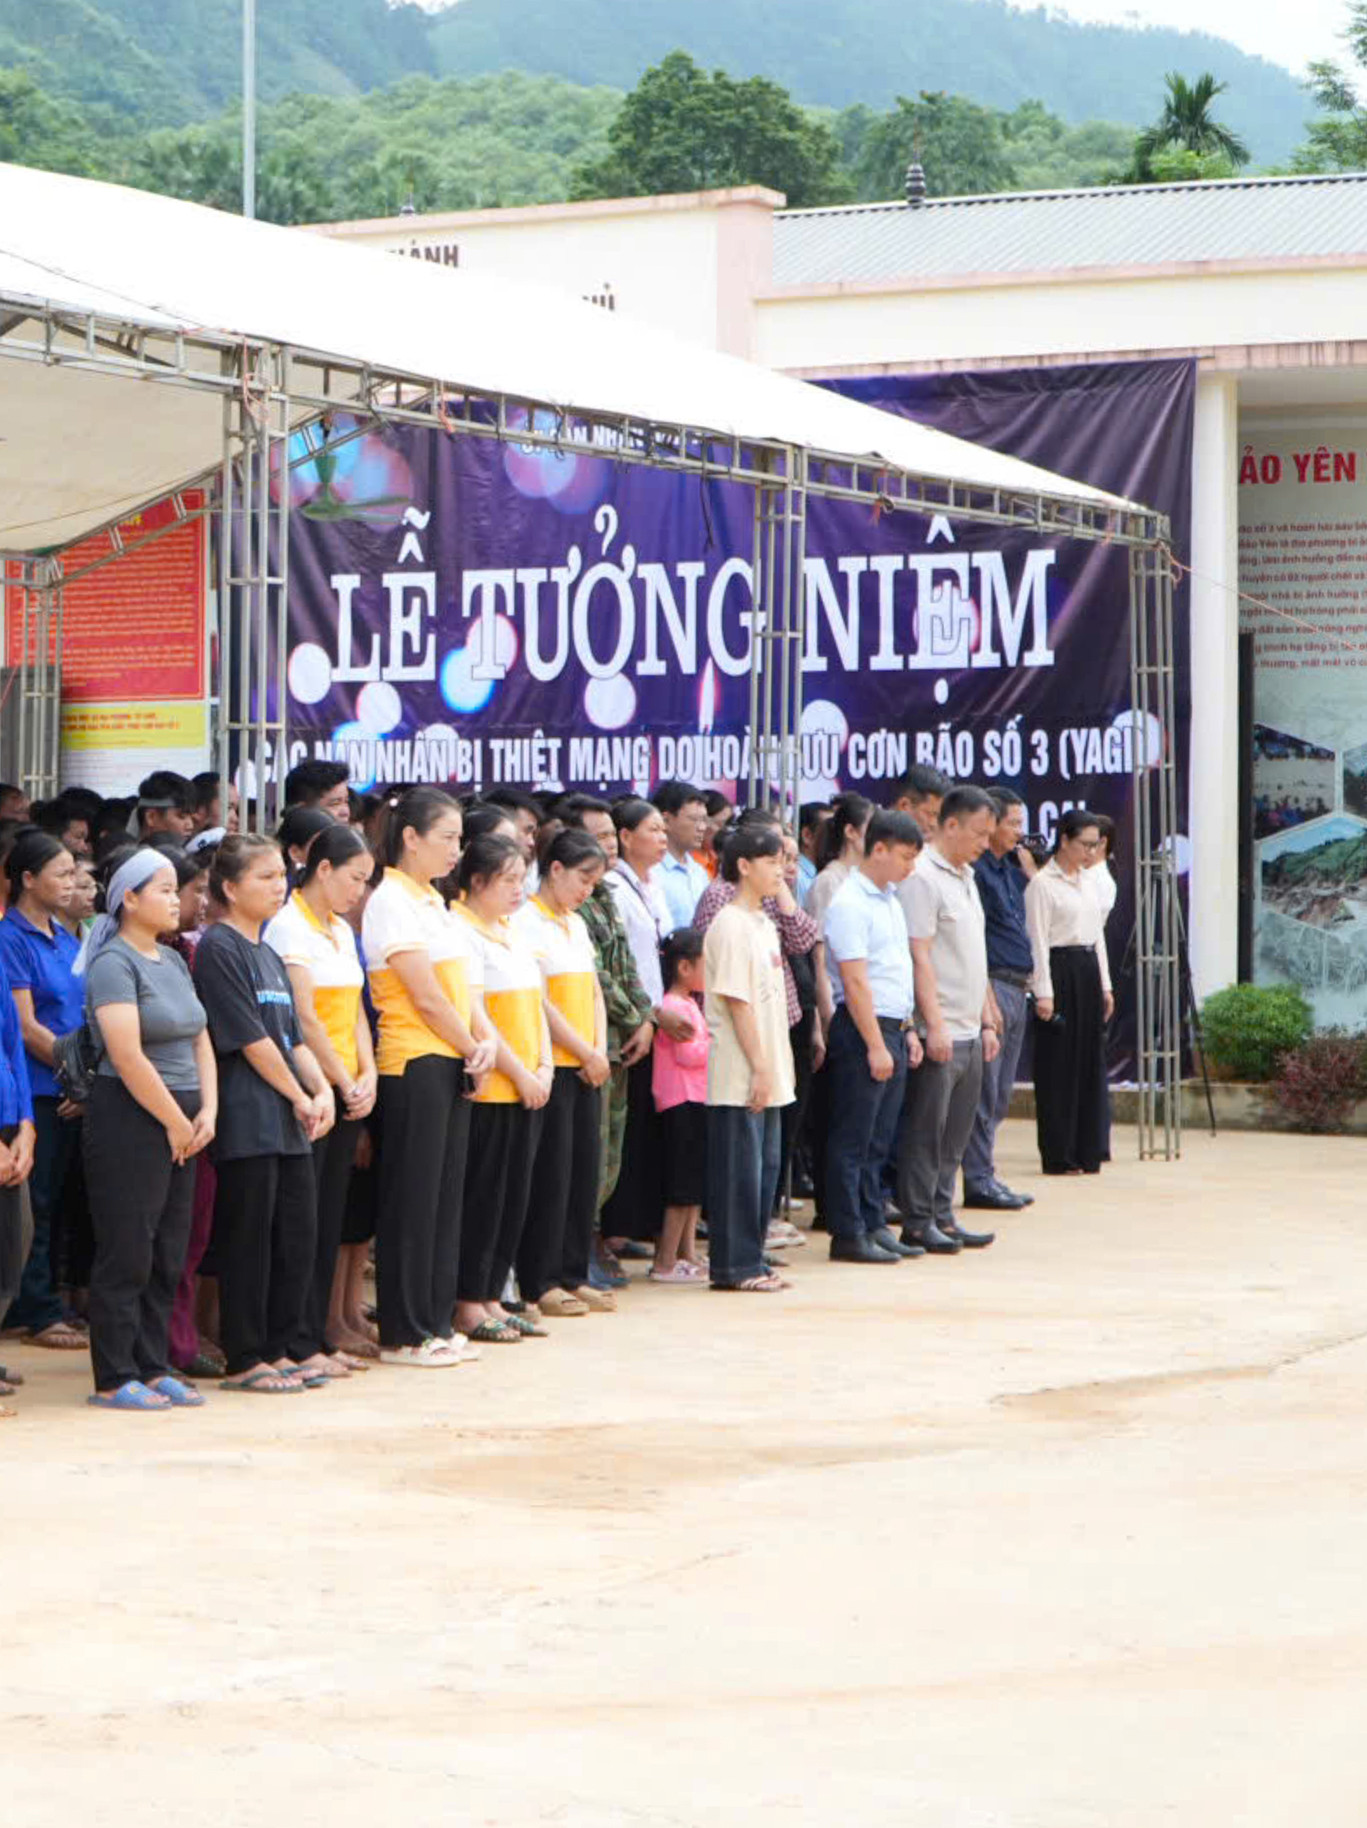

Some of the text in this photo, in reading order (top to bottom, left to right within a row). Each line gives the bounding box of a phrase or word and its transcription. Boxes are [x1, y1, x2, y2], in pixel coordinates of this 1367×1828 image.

[1239, 445, 1356, 484] ẢO YÊN
[331, 506, 436, 682] LỄ
[462, 504, 767, 682] TƯỞNG
[802, 513, 1056, 704] NIỆM
[375, 729, 449, 783] NHÂN
[457, 738, 482, 792] BỊ
[489, 728, 562, 790] THIỆT
[569, 736, 650, 791] MẠNG
[658, 735, 695, 781] DO
[848, 728, 908, 779] CƠN
[916, 722, 974, 777] BÃO
[983, 714, 1023, 777] SỐ
[1031, 729, 1049, 776] 3
